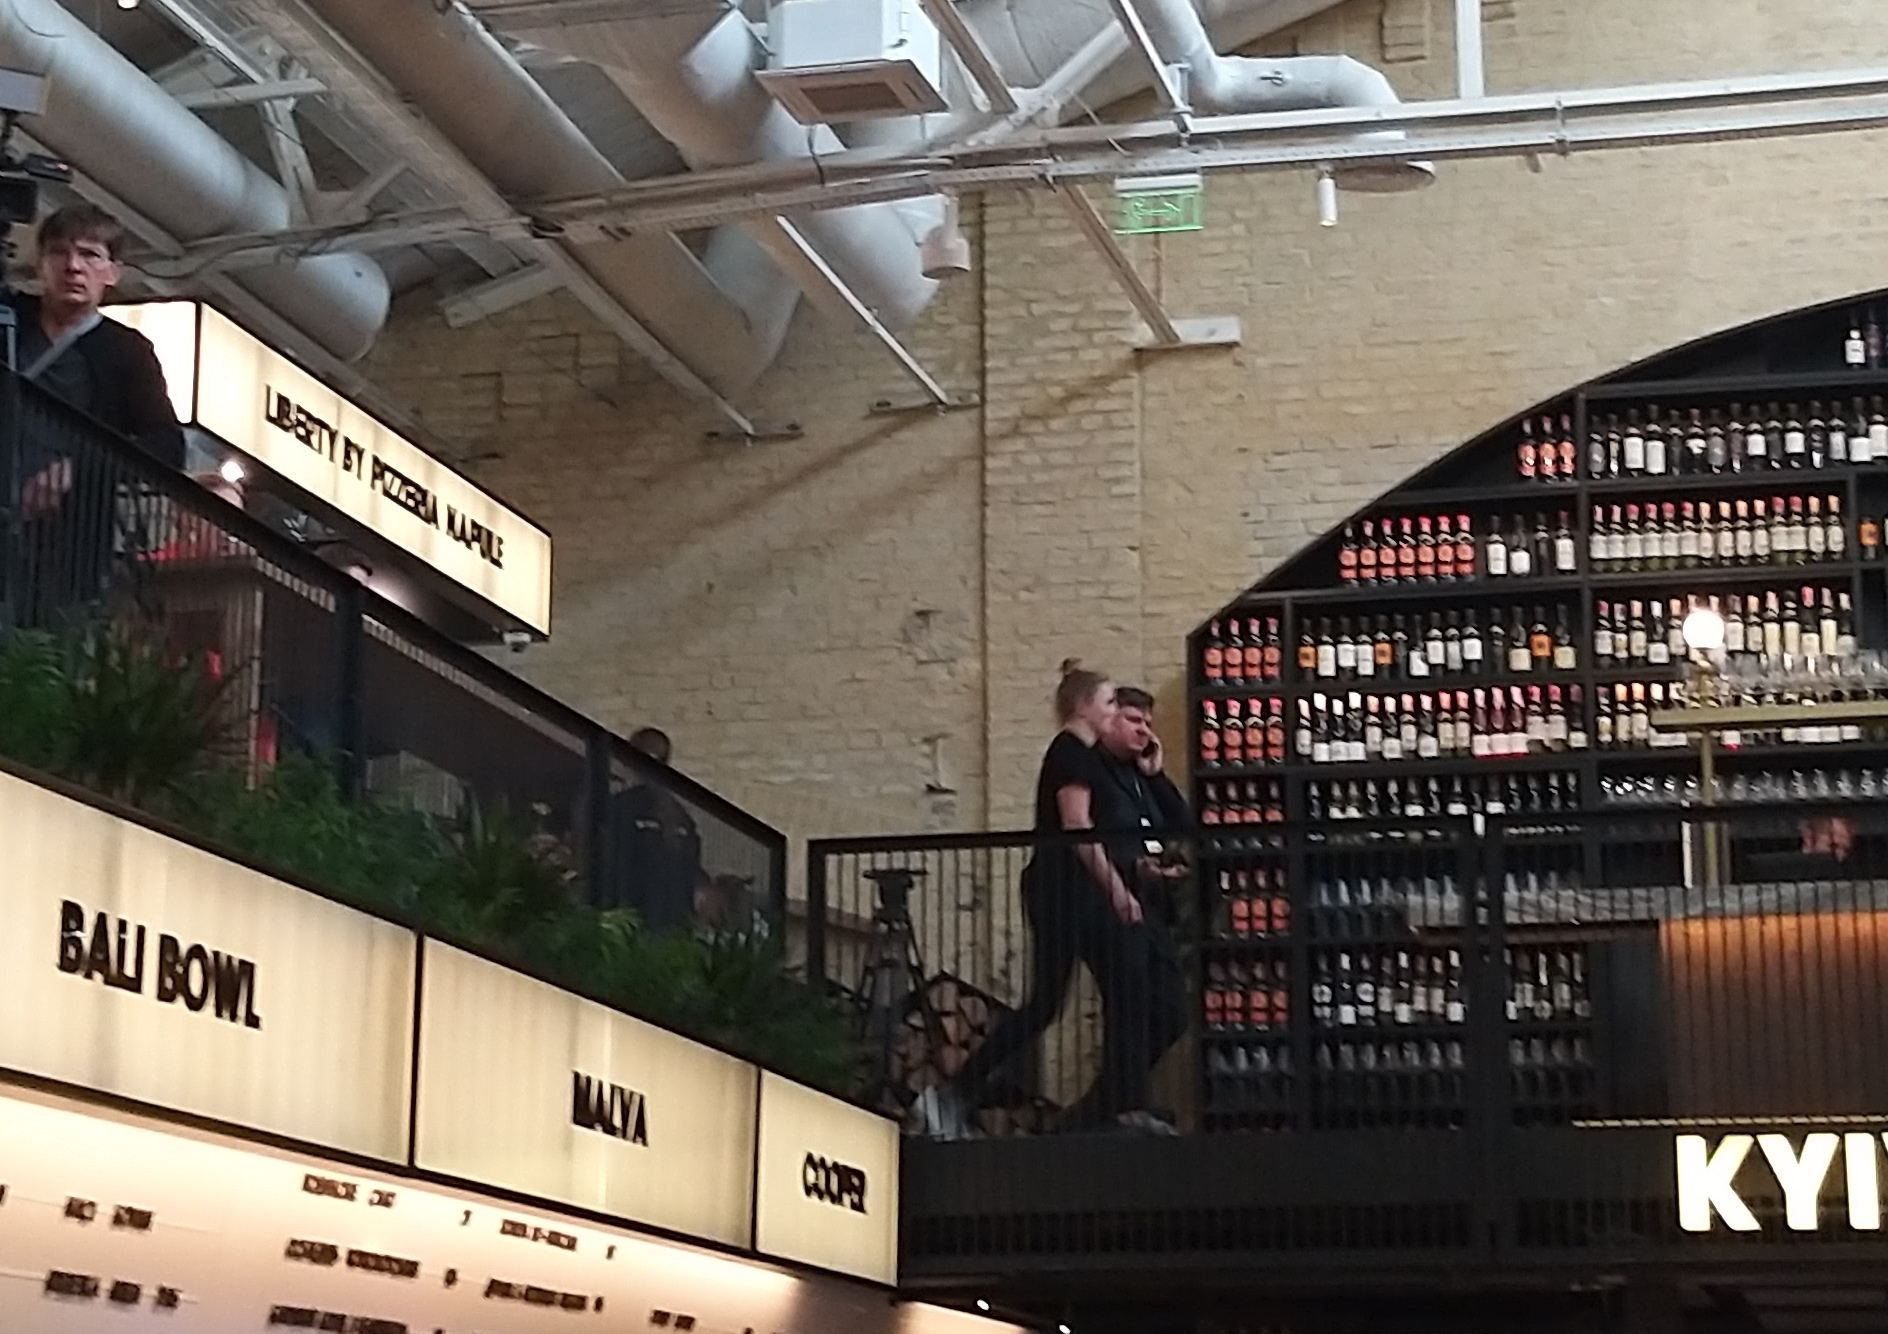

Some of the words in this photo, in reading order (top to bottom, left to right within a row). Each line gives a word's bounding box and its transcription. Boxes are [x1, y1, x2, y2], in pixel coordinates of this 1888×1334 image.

[265, 383, 339, 463] LIBERTY
[342, 435, 366, 481] BY
[57, 899, 146, 995] BALI
[157, 933, 264, 1030] BOWL
[802, 1151, 868, 1216] COOPER
